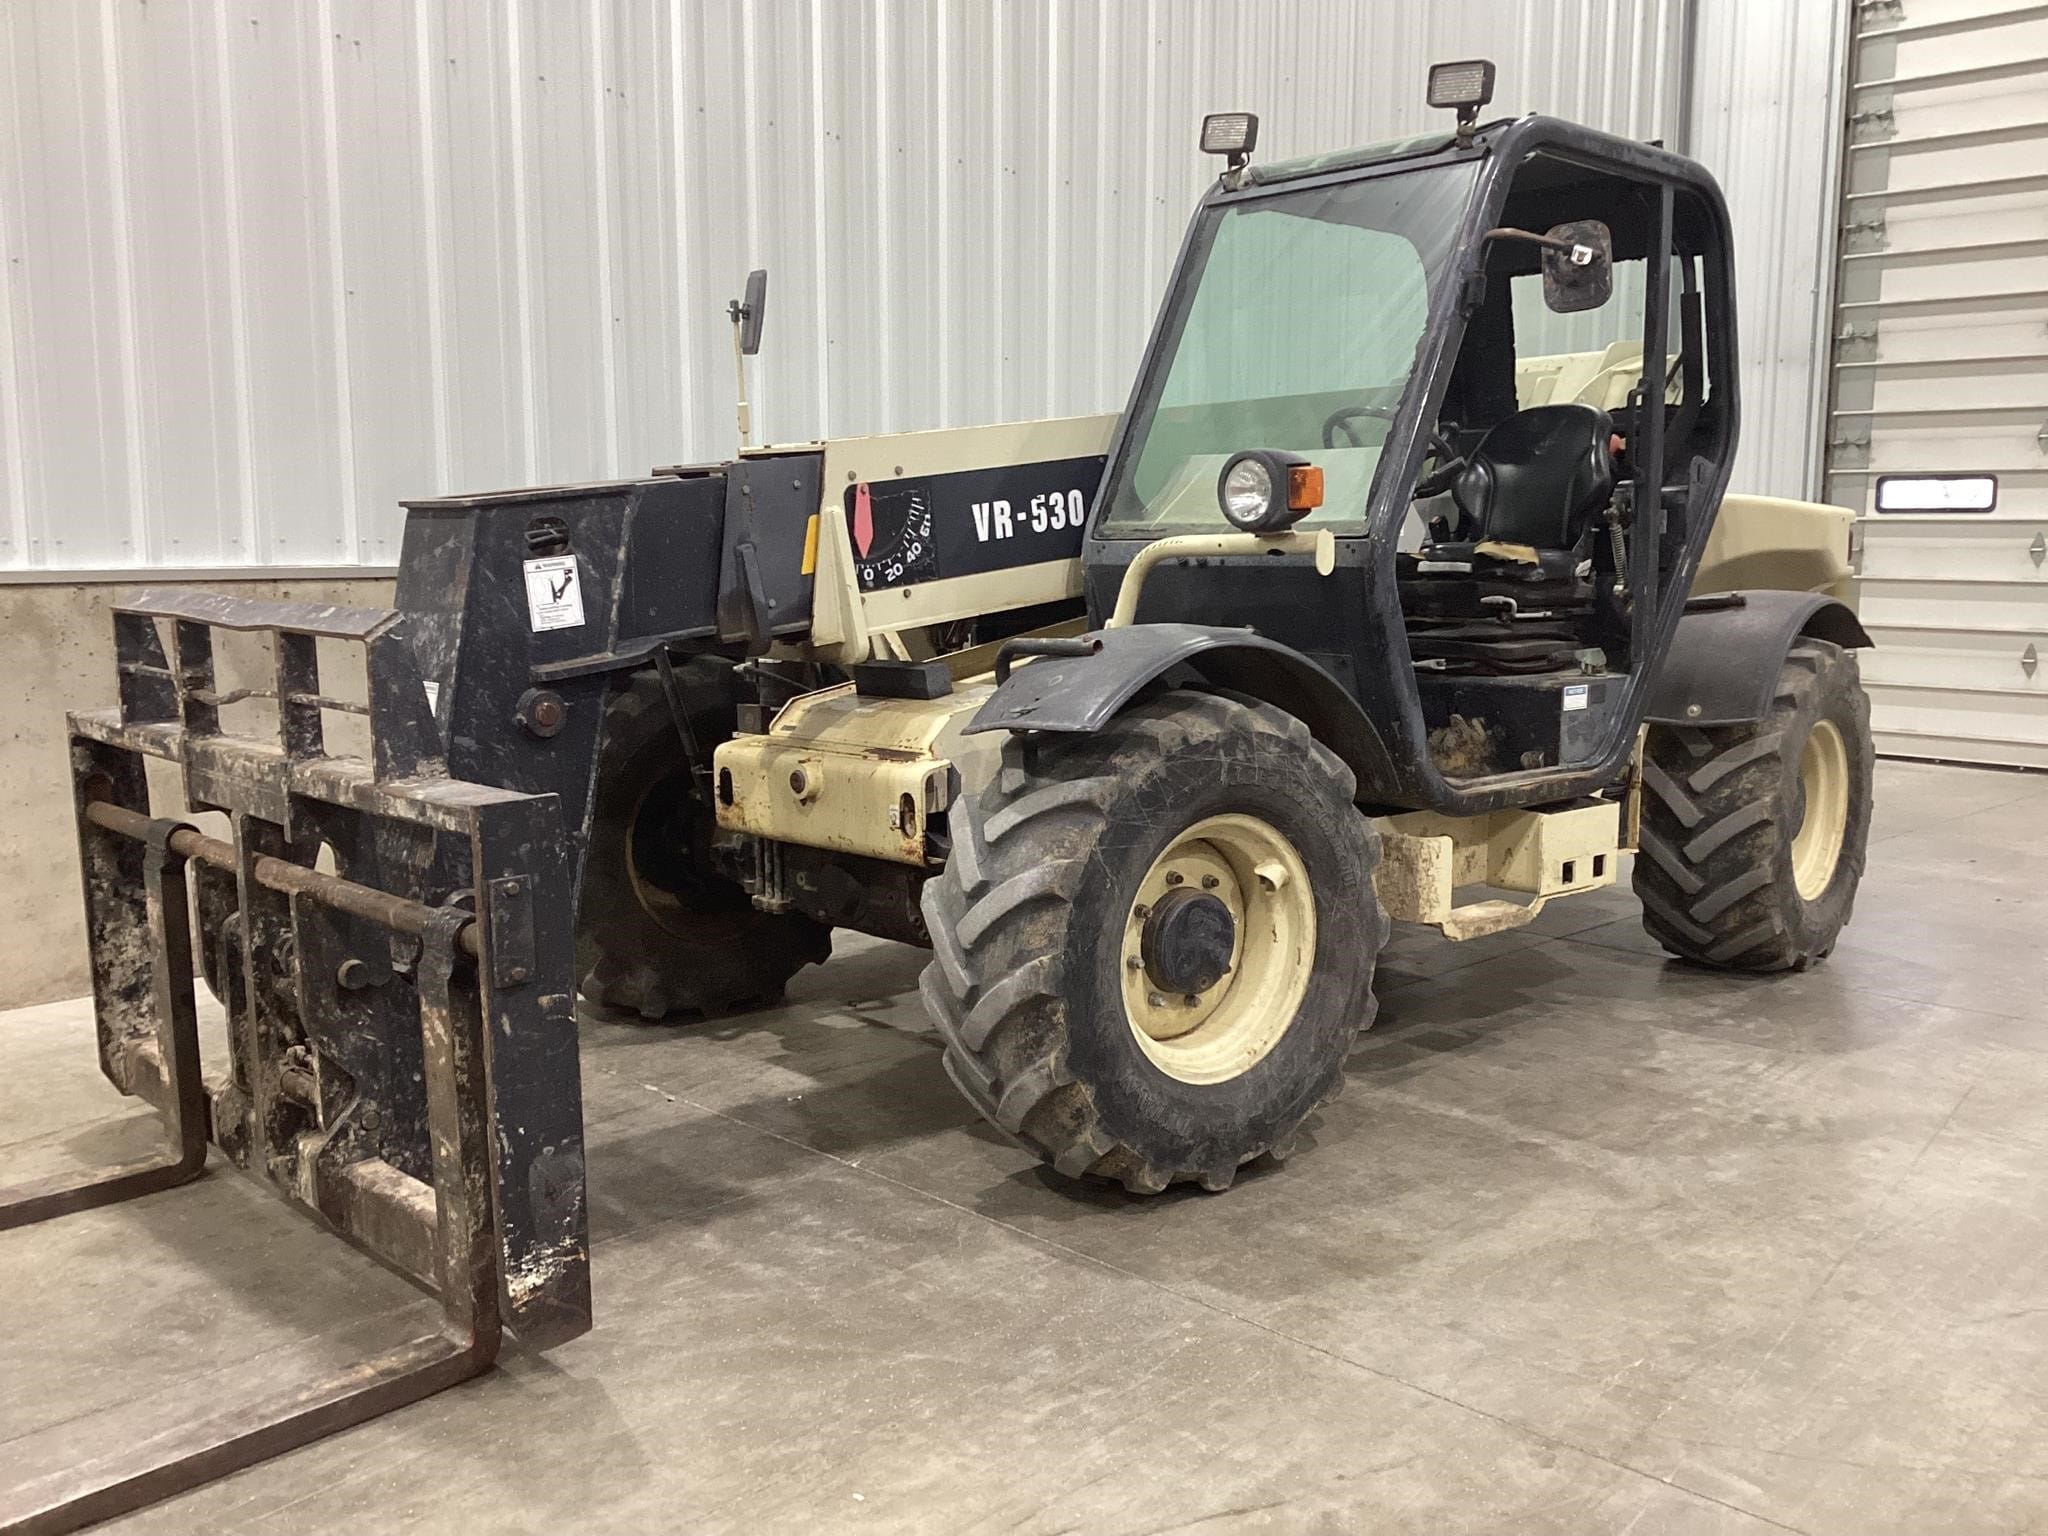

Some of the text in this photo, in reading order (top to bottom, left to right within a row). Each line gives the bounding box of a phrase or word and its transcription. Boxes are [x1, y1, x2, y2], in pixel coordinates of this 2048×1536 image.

[971, 489, 1085, 543] VR-530
[863, 568, 874, 581] 0
[884, 563, 904, 582] 20
[906, 541, 922, 563] 40
